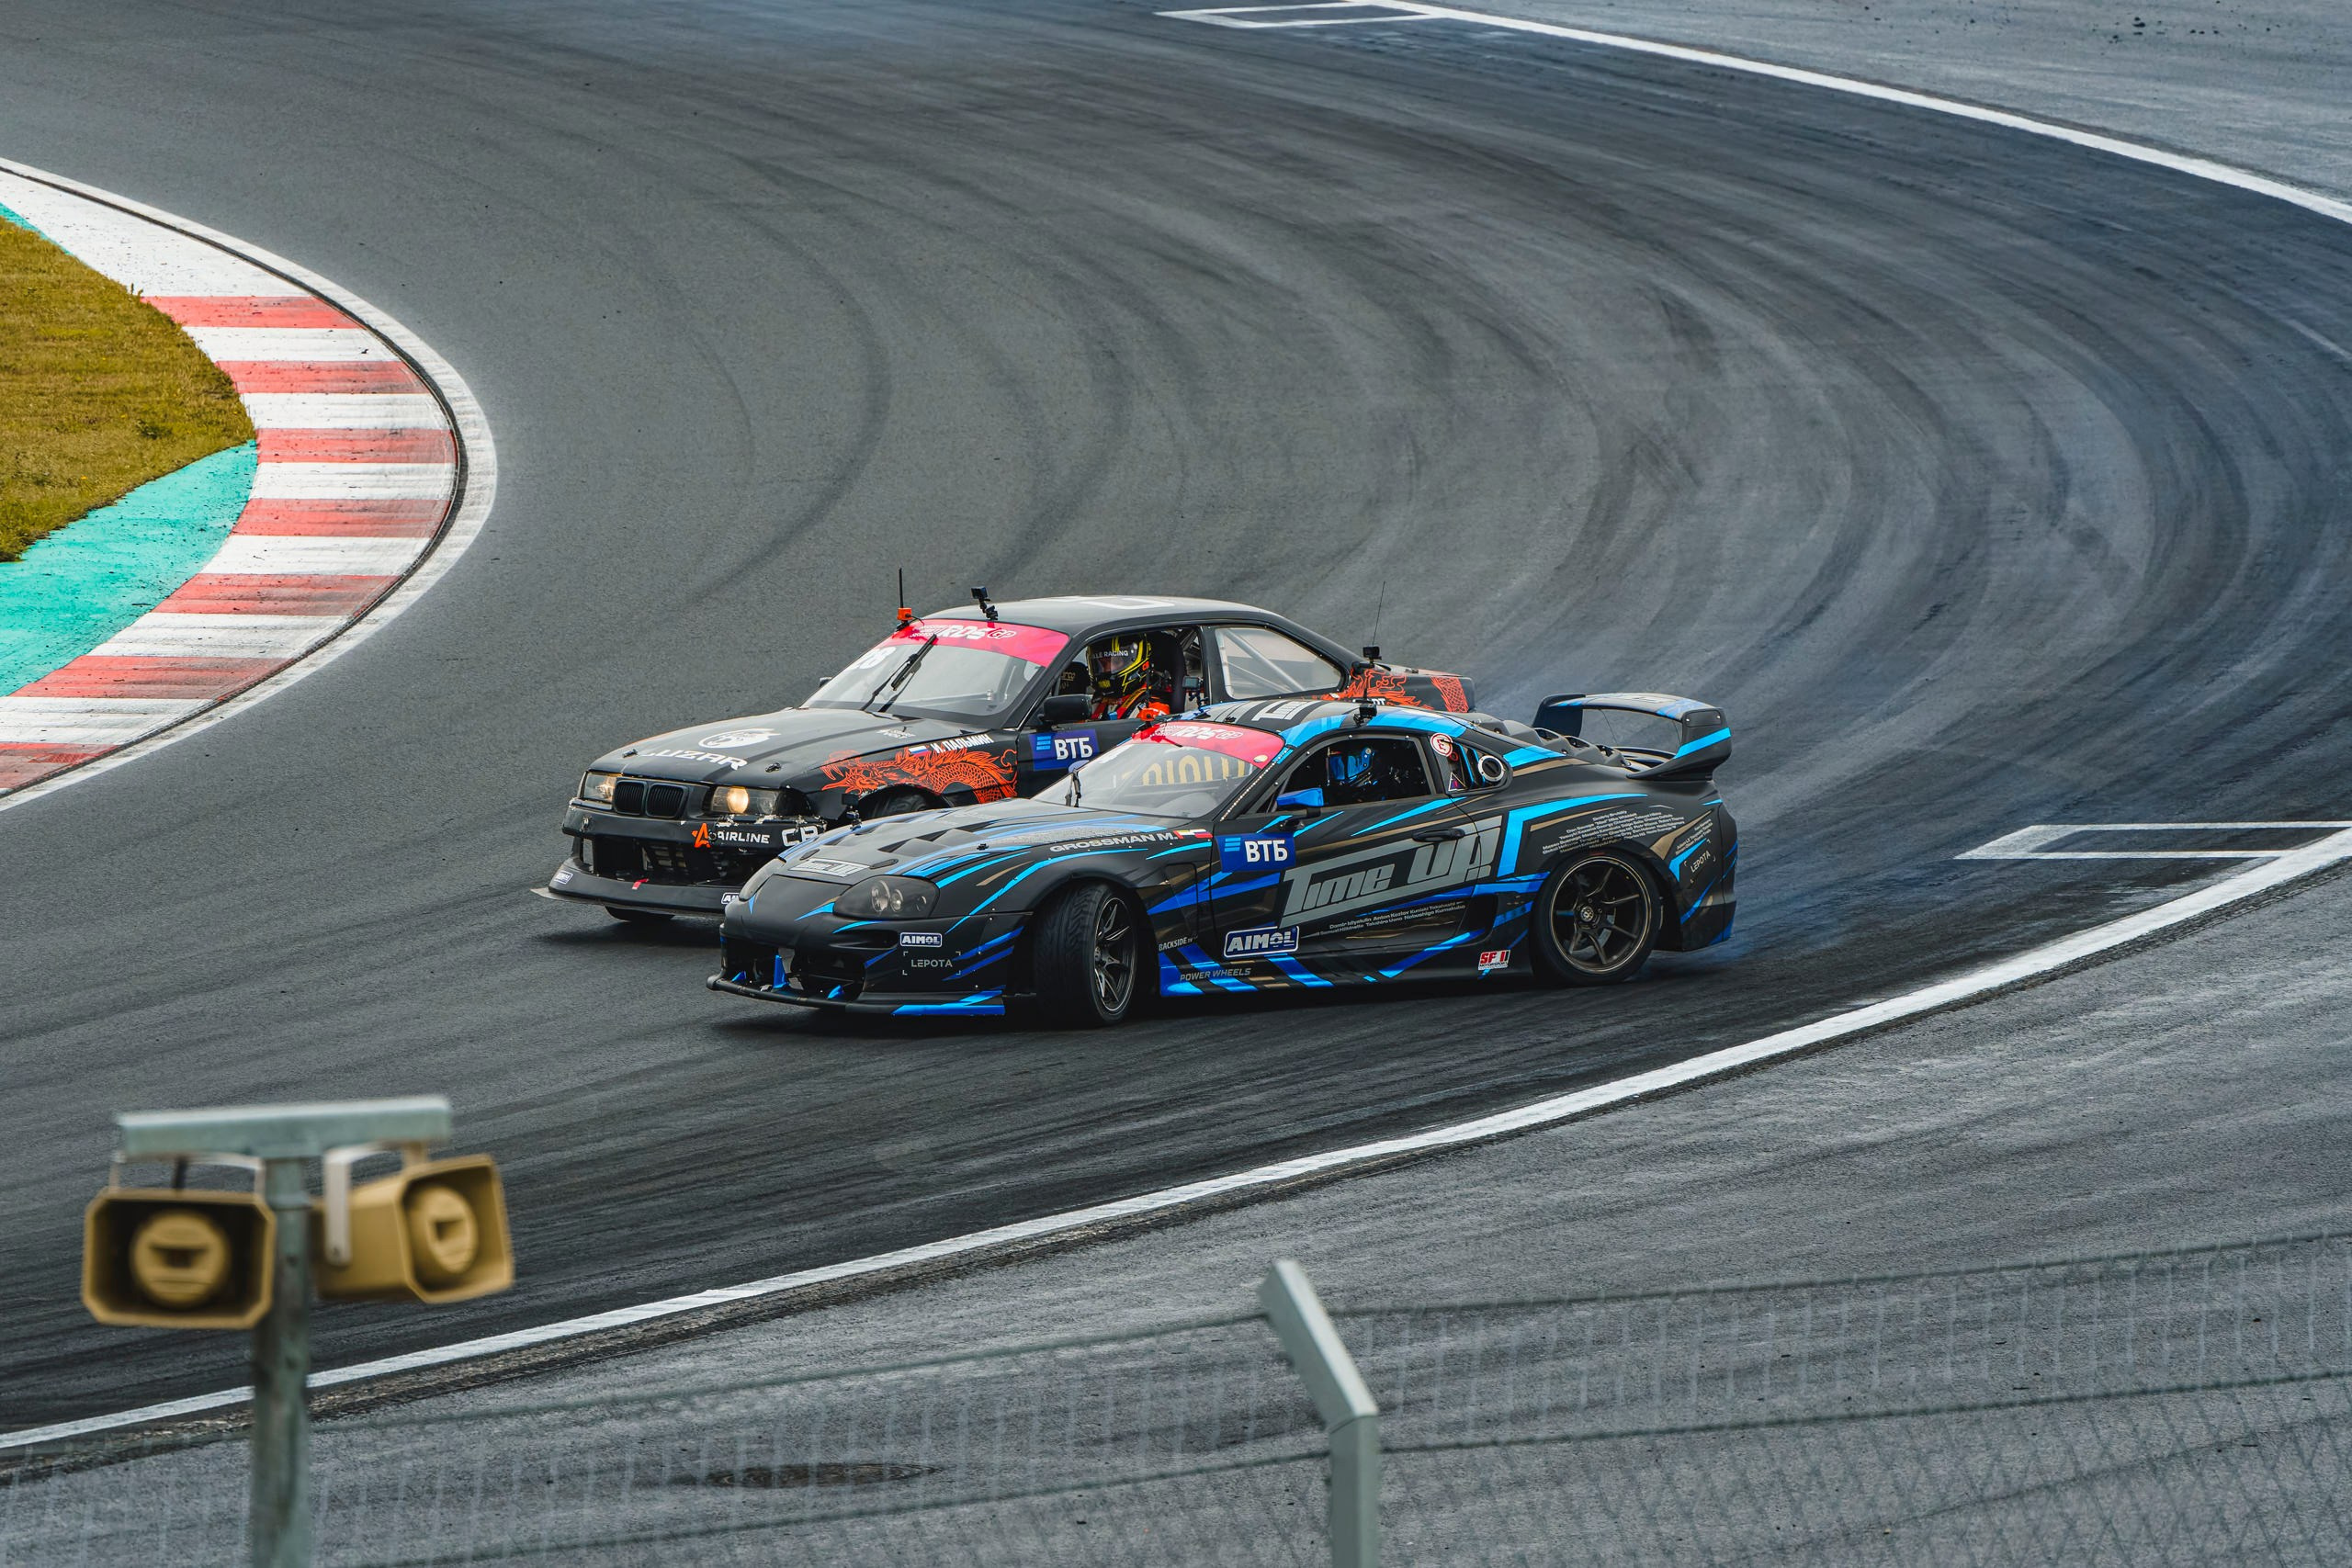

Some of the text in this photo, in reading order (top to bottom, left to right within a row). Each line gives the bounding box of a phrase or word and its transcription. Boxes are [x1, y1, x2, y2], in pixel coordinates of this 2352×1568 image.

[942, 734, 994, 750] ПАЛЬМИН
[1054, 737, 1093, 761] ВТБ
[718, 831, 770, 844] AIRLINE
[1049, 833, 1157, 852] GROSSMAN
[1244, 840, 1288, 863] ВТБ
[1690, 851, 1711, 873] LEPOTA
[901, 935, 940, 945] AIMOL
[1158, 936, 1188, 952] BACKSIDE
[1227, 931, 1295, 953] AIMOL
[910, 959, 953, 968] LEPOTA
[1180, 967, 1252, 981] POWER WHEELS
